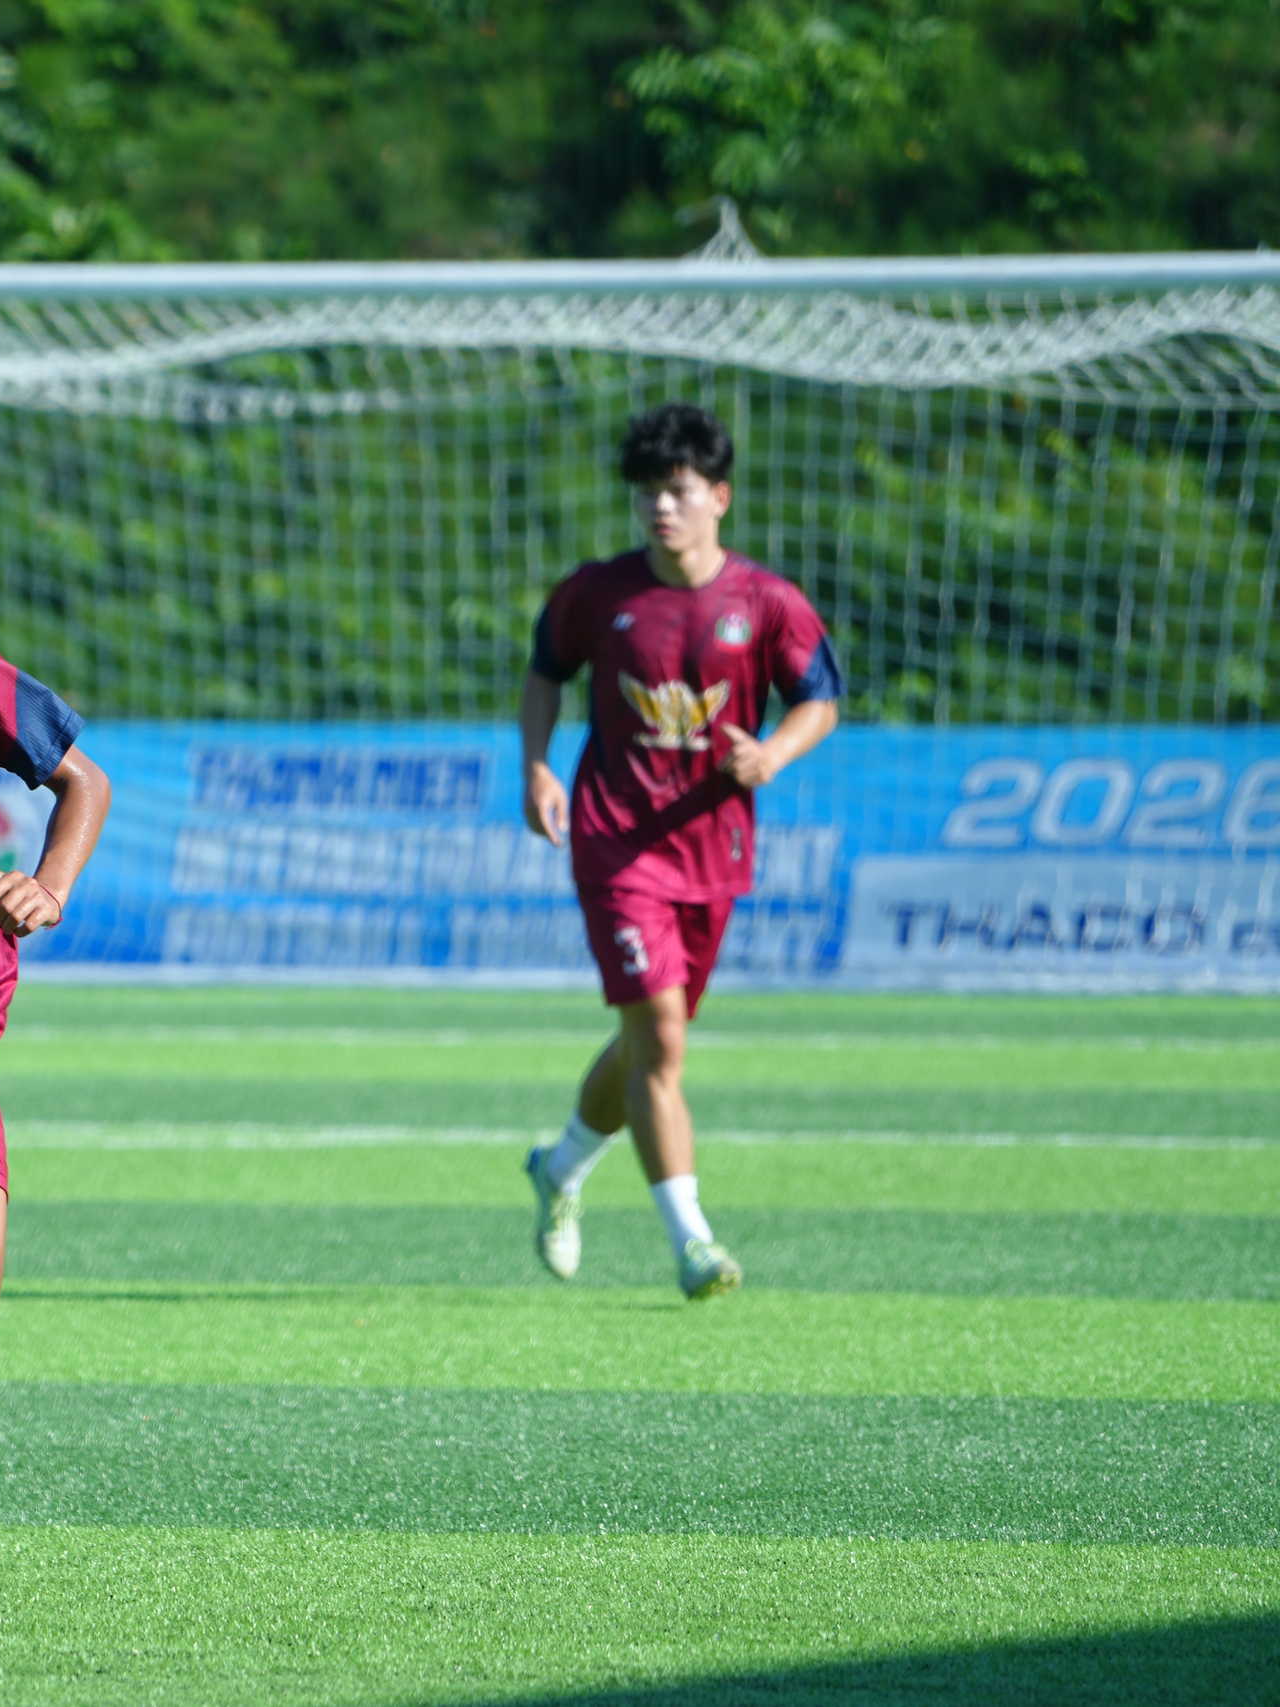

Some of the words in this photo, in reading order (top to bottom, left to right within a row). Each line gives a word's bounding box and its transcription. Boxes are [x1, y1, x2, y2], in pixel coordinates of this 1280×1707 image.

[941, 756, 1280, 847] 2026
[614, 925, 650, 976] 3
[885, 901, 1204, 956] THACO
